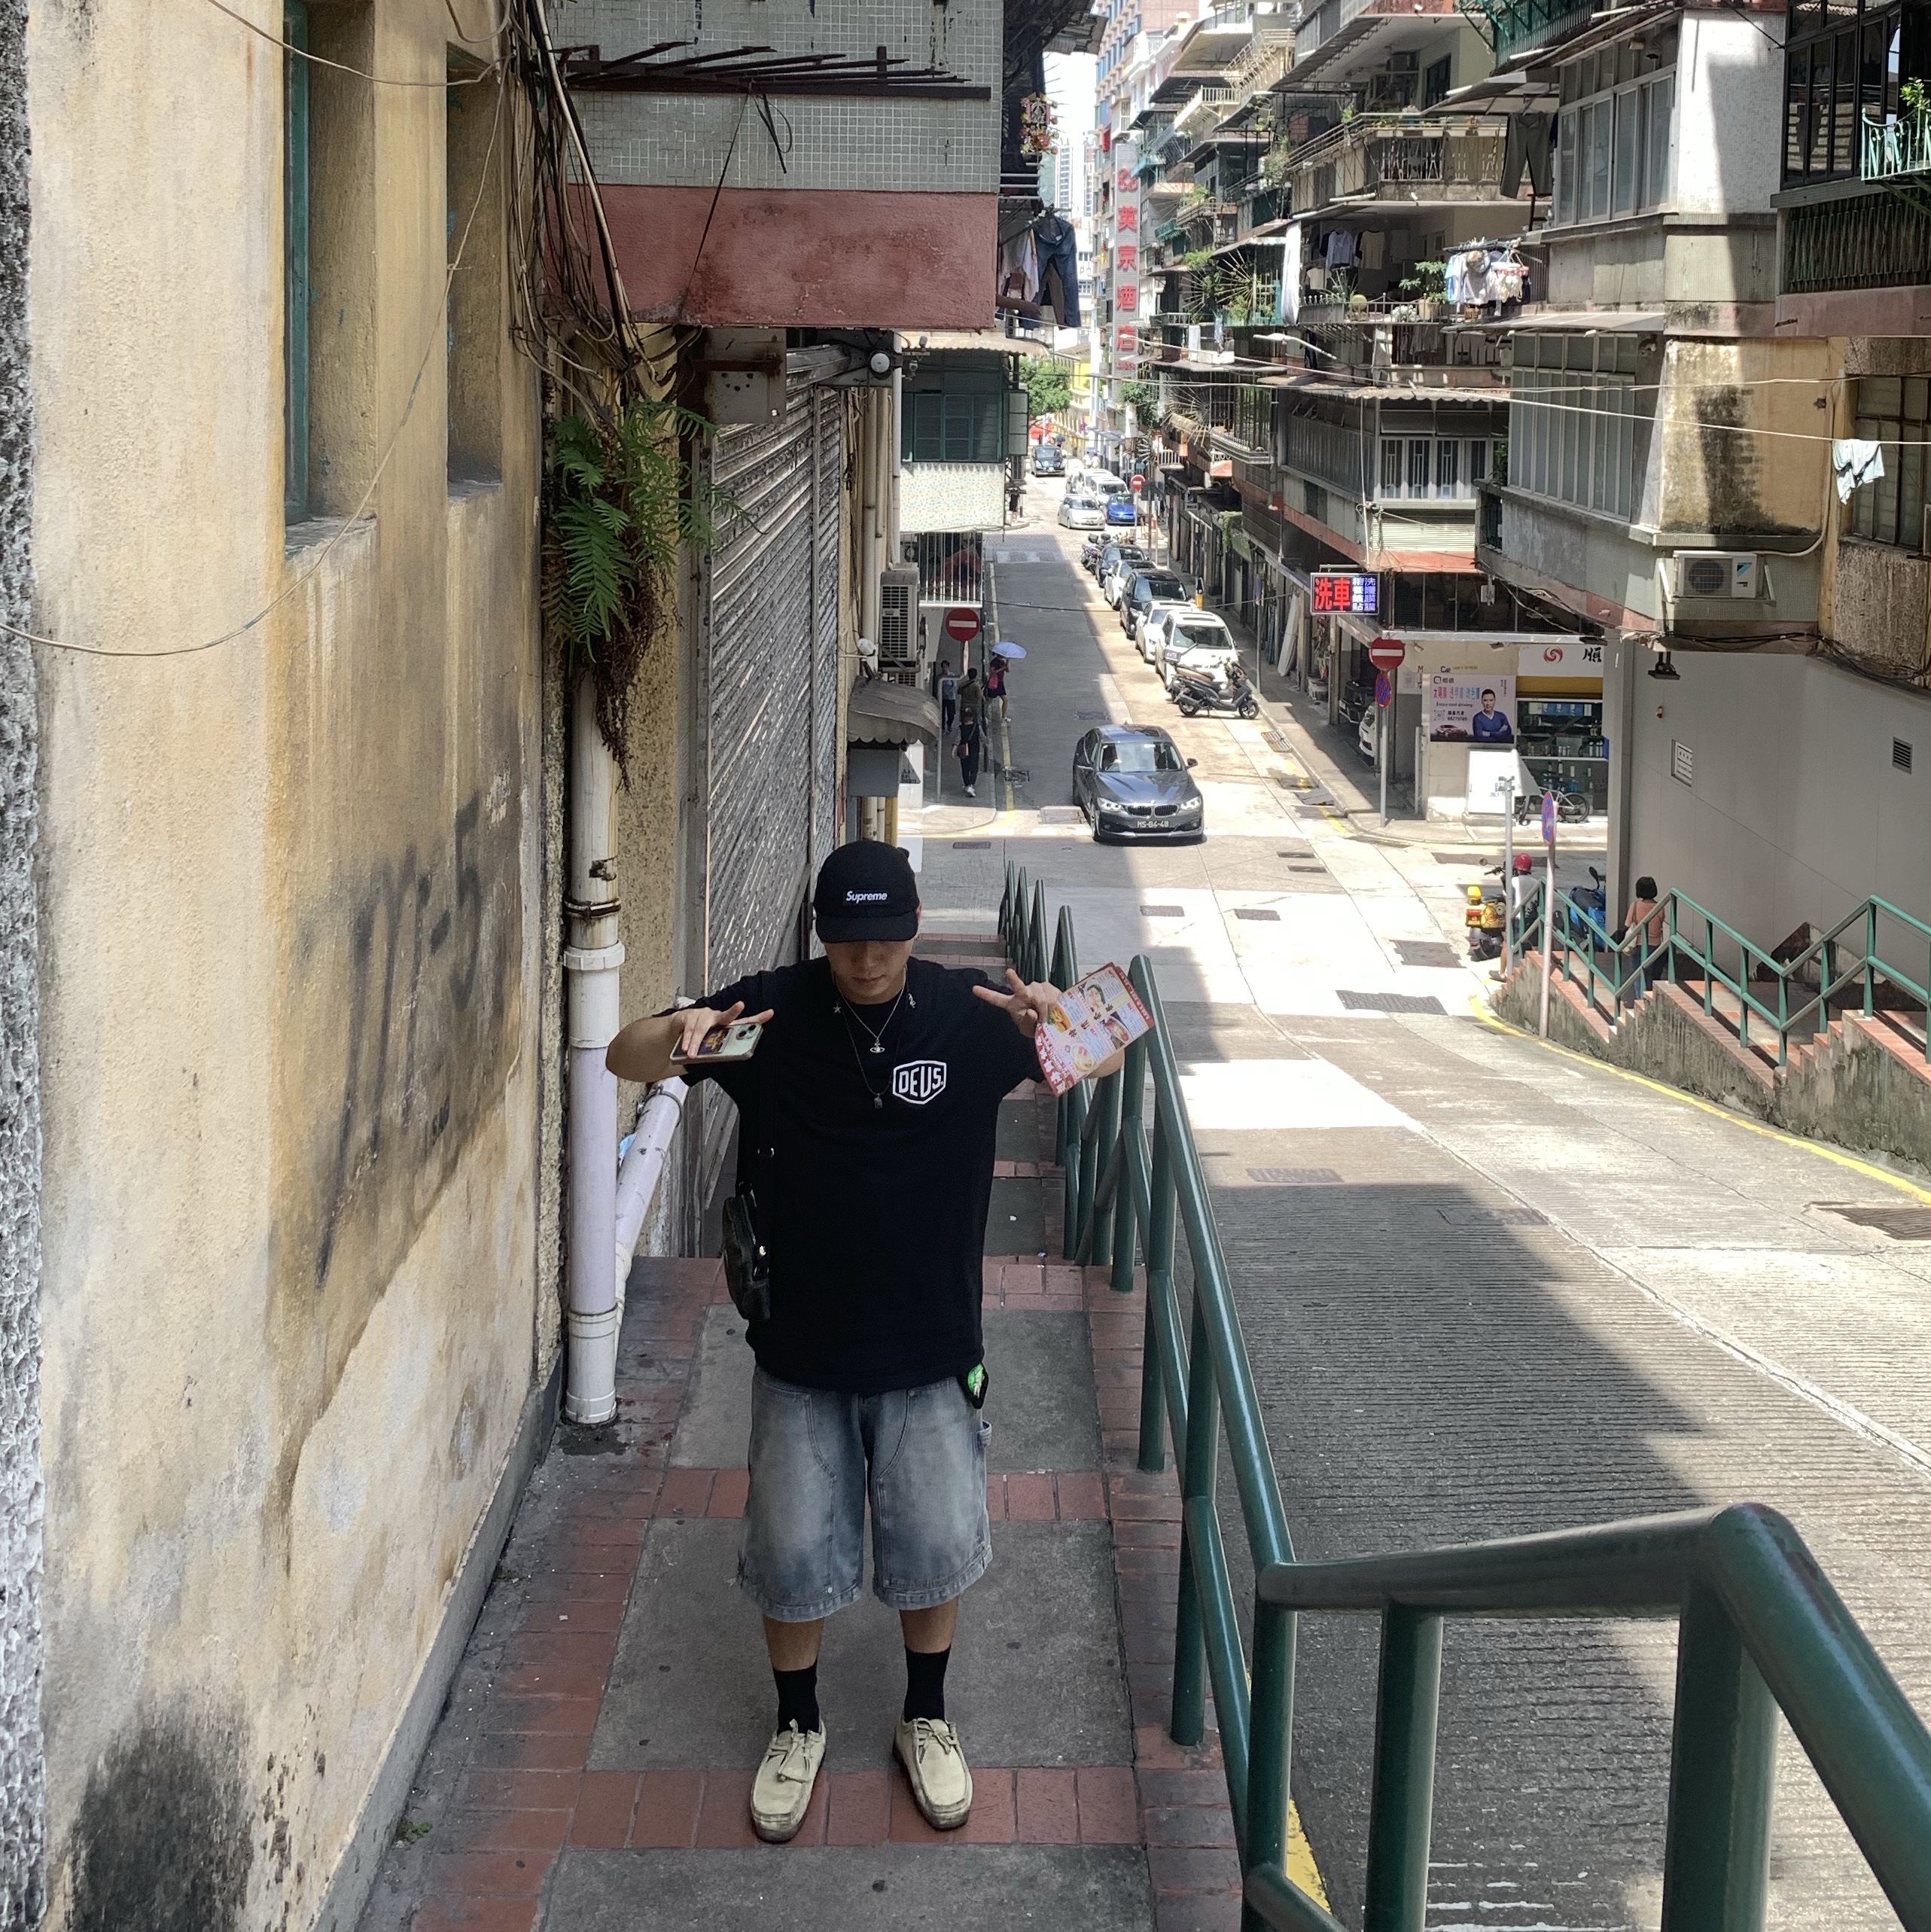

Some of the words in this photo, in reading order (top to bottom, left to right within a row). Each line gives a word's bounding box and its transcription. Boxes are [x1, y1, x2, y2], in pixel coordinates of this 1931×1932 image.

[1116, 205, 1137, 351] 英京酒店
[1315, 577, 1351, 610] 洗車
[1582, 647, 1602, 663] 順
[845, 890, 888, 904] Supreme
